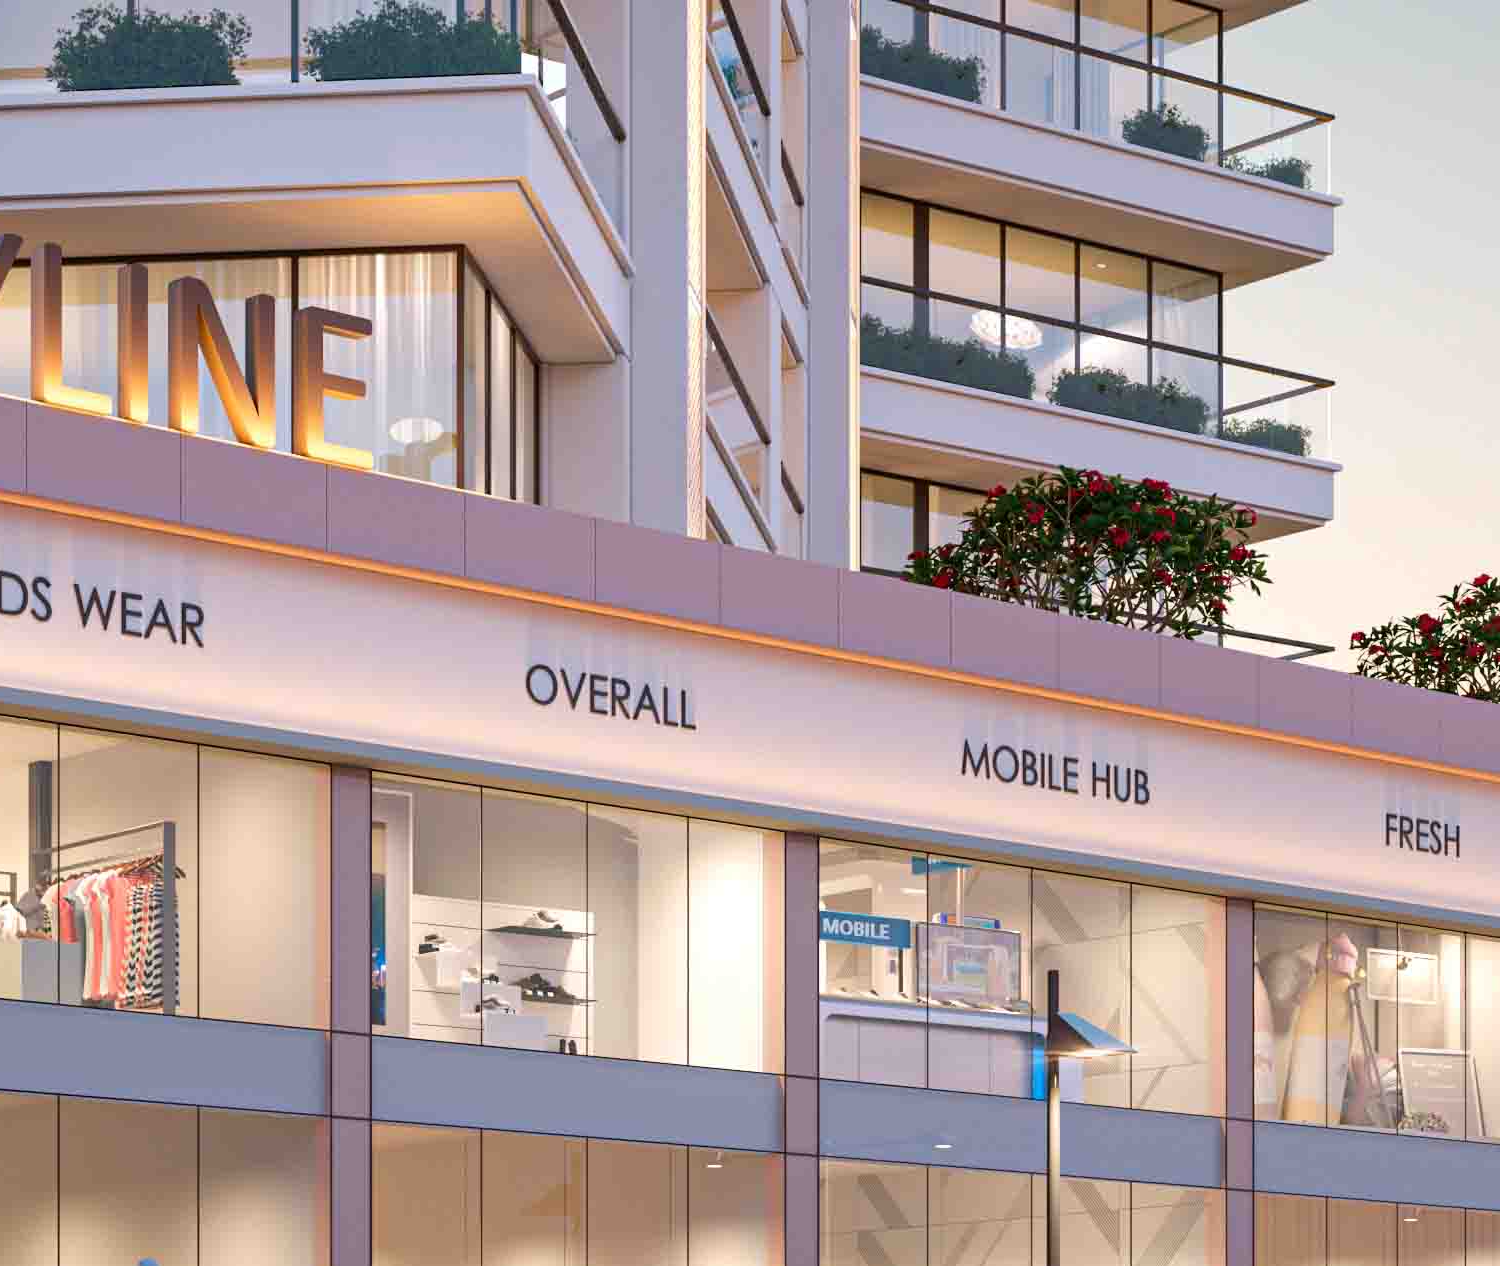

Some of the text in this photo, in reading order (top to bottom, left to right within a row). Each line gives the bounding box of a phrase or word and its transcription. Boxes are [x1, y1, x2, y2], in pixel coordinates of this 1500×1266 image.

[73, 582, 205, 649] WEAR
[525, 663, 697, 731] OVERALL
[960, 738, 1151, 806] MOBILE HUB
[1385, 812, 1461, 859] FRESH
[822, 917, 892, 940] MOBILE
